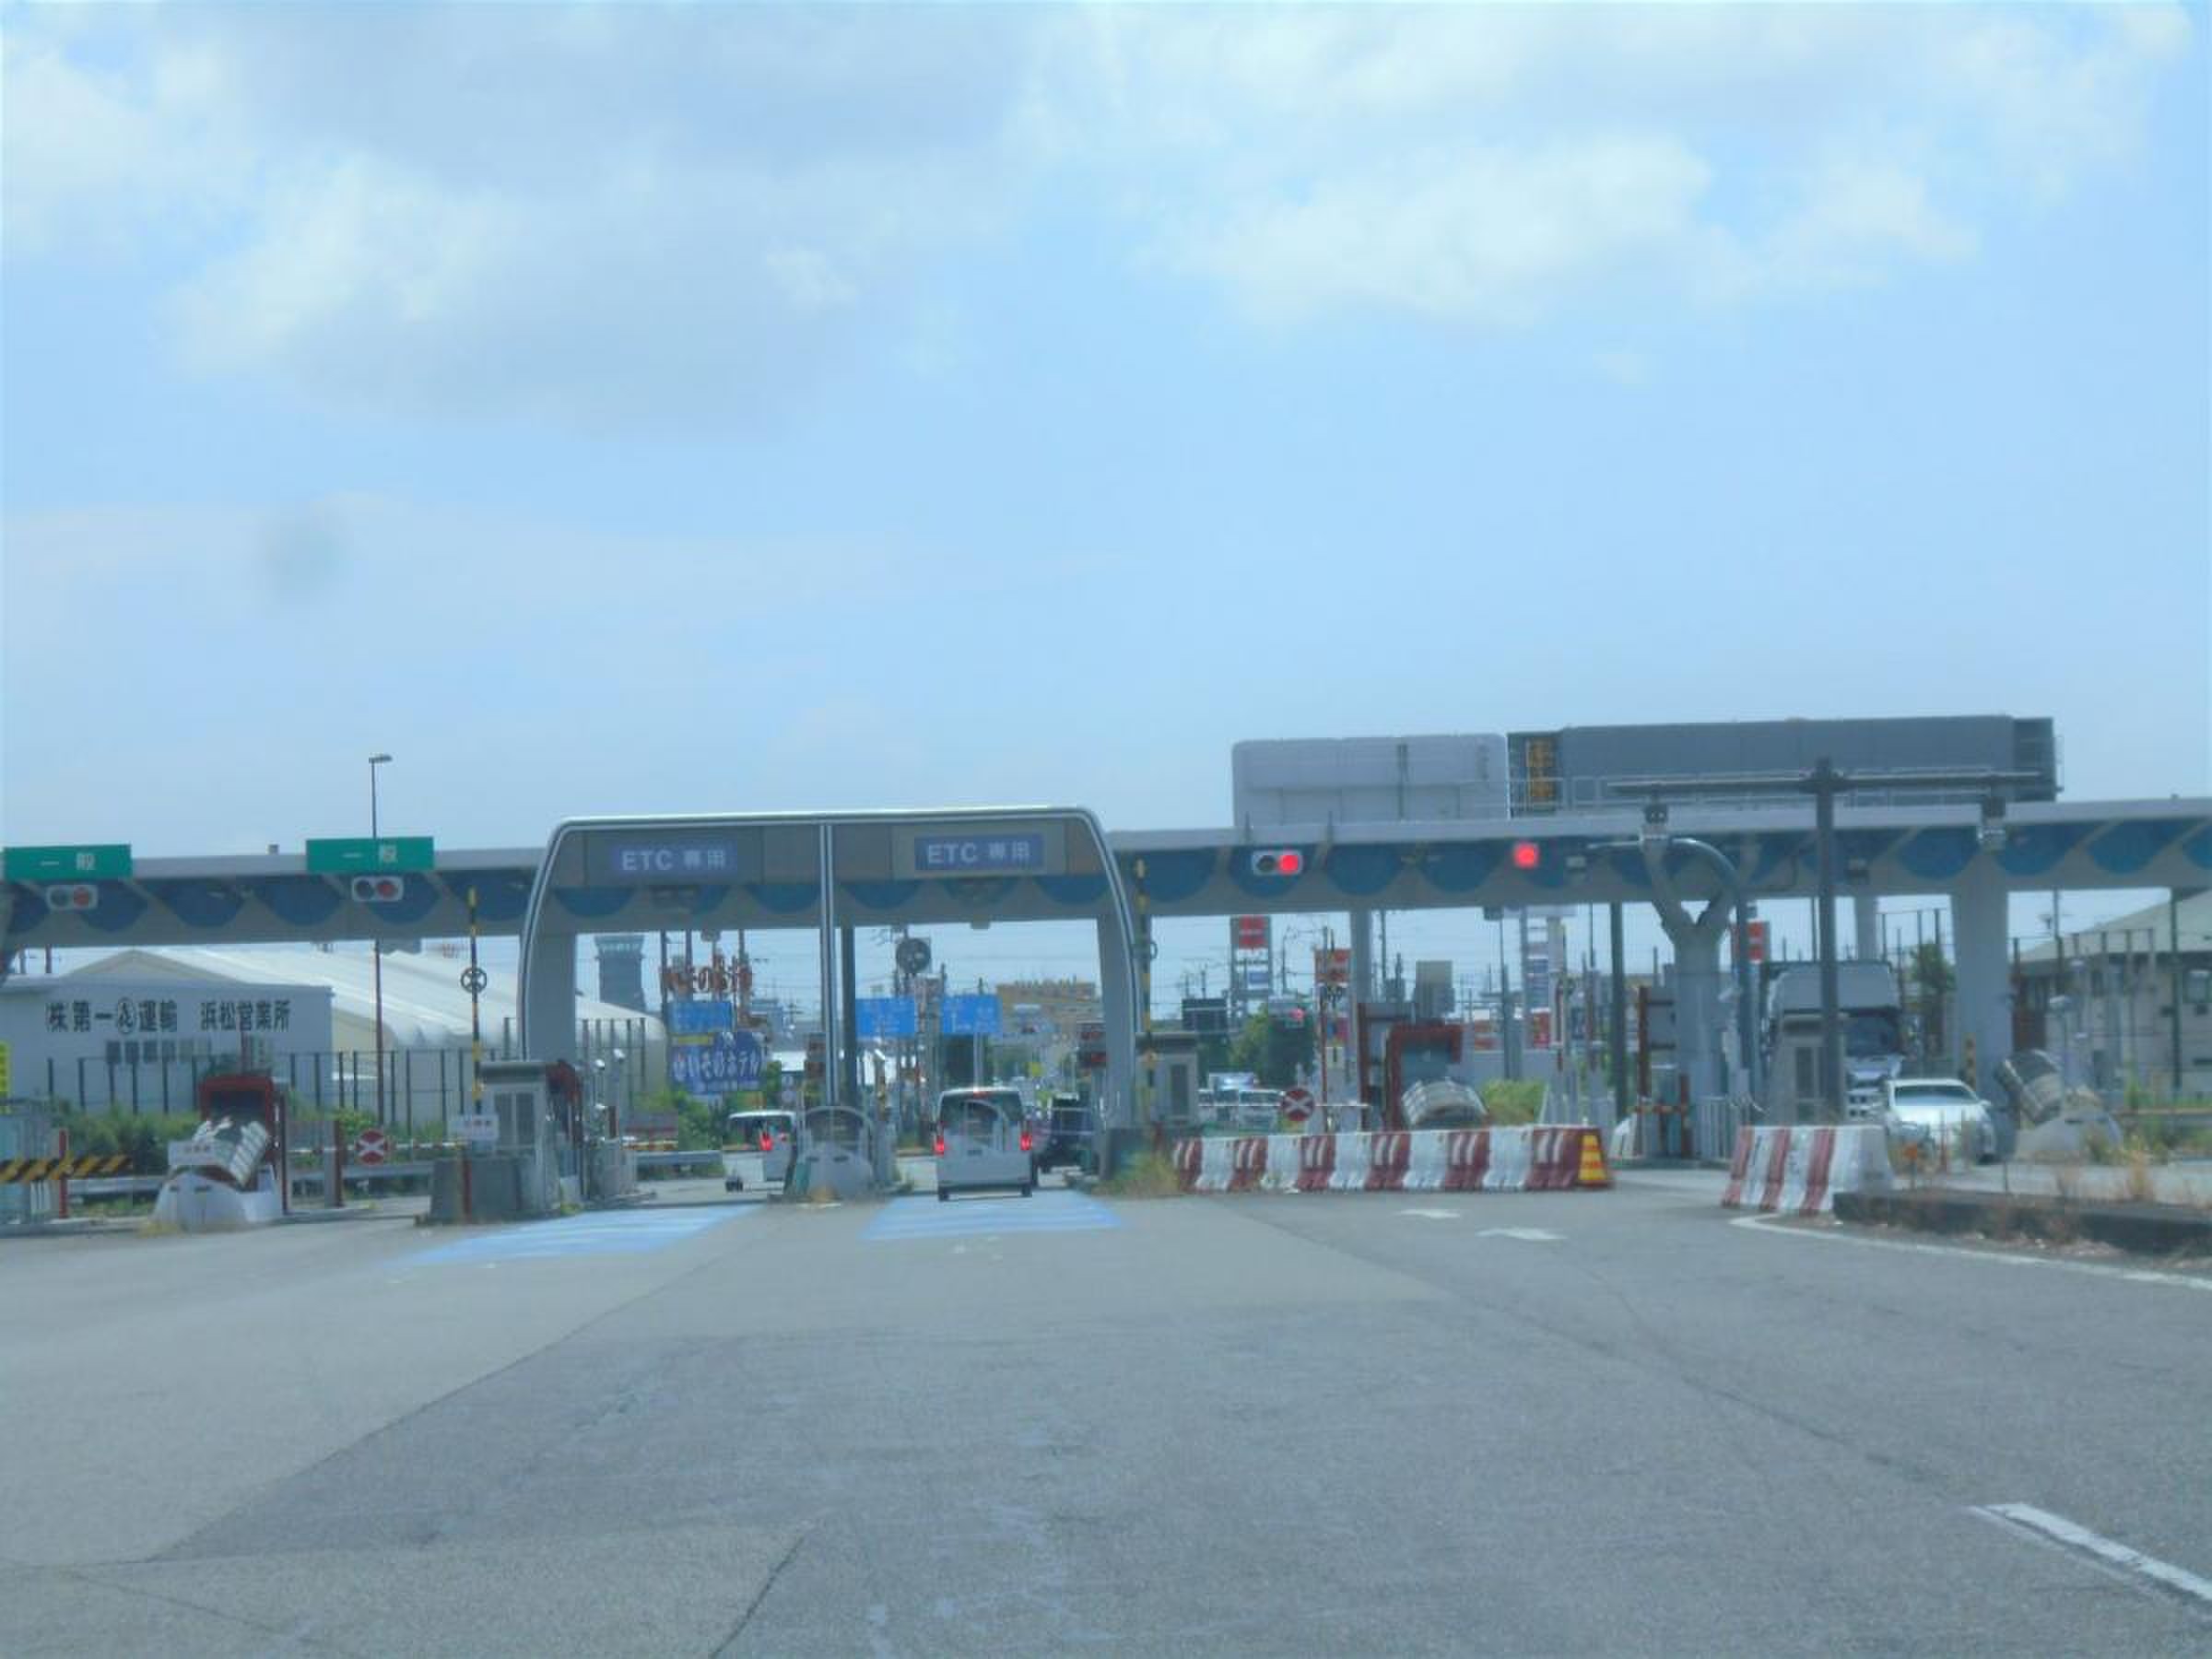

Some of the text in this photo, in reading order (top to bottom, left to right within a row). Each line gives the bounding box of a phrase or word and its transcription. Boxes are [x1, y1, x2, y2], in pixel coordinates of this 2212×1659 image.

[621, 848, 726, 870] ETC 専用
[927, 840, 1030, 864] ETC 専用
